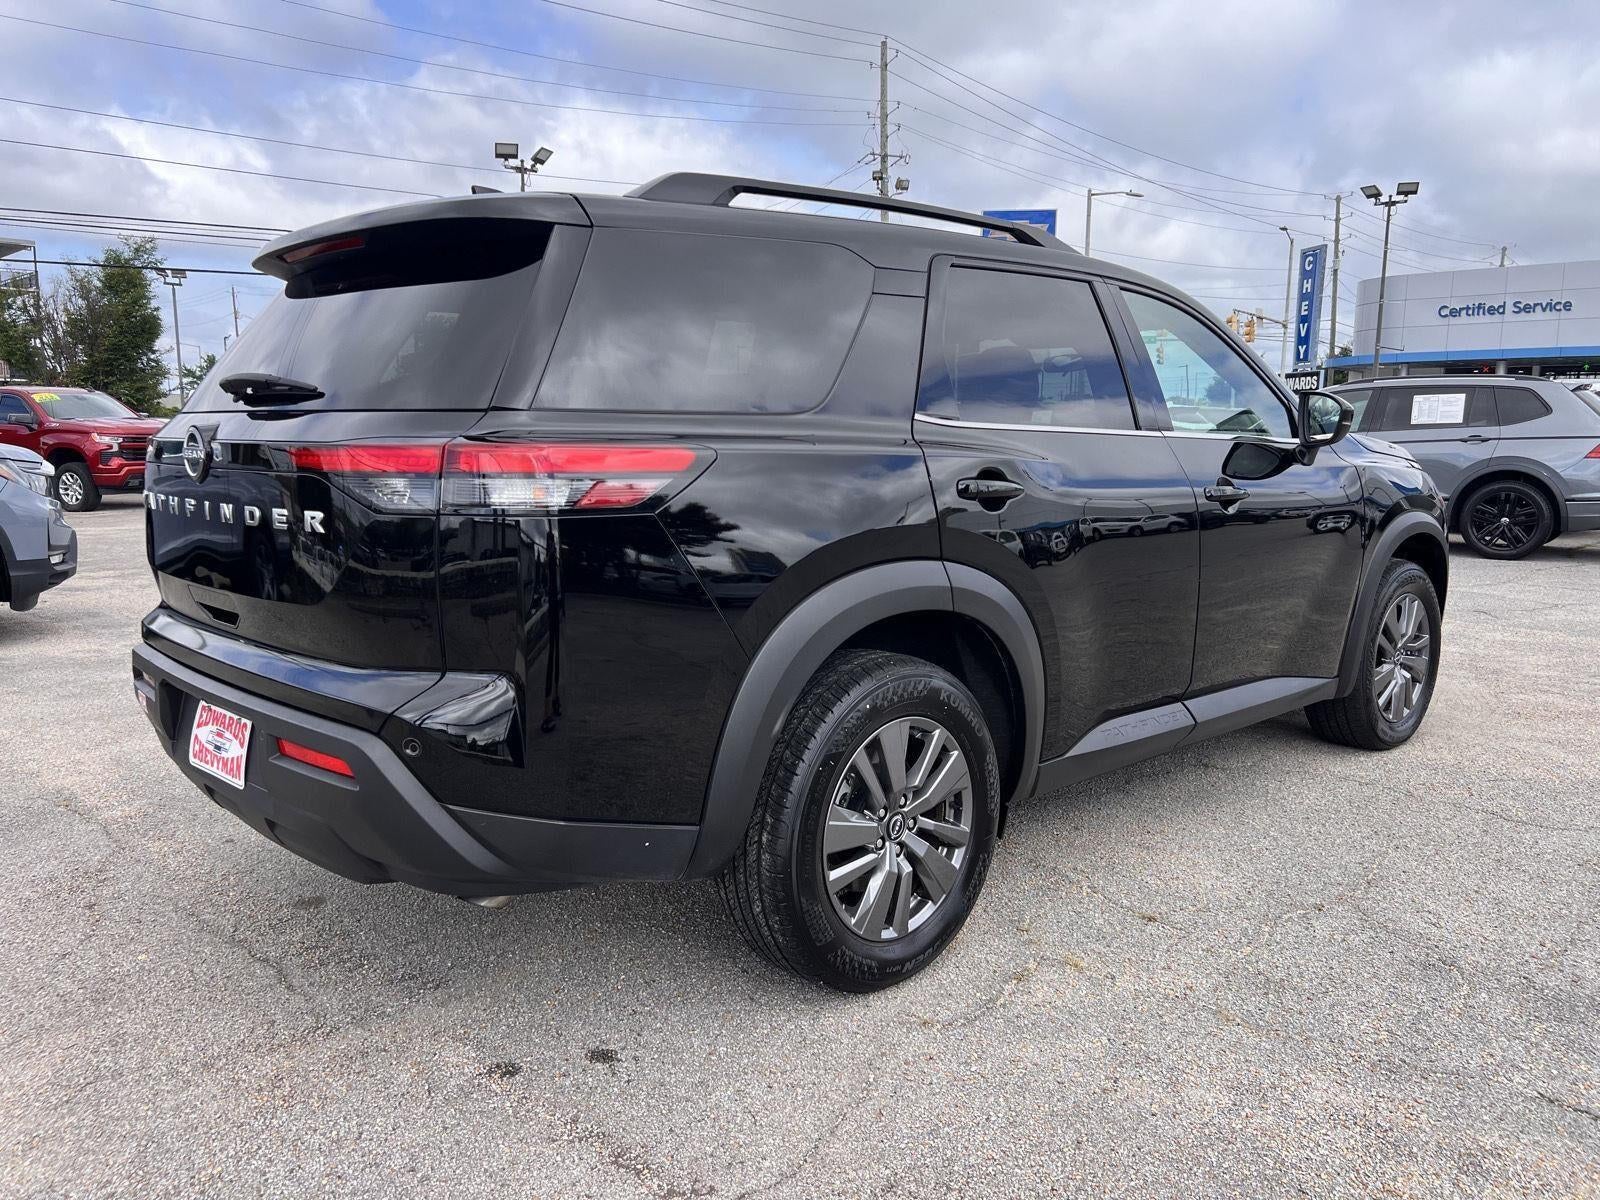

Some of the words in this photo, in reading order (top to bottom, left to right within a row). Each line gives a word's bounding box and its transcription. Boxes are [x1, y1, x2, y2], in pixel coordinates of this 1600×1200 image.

[1297, 256, 1314, 360] CHEVY
[1437, 301, 1507, 318] Certified
[1512, 298, 1573, 315] Service
[1286, 375, 1318, 390] WARDS
[184, 449, 205, 460] SSAN
[196, 704, 248, 750] EDWARDS
[939, 689, 984, 737] KUMHO
[192, 733, 243, 781] CHEVYMAN
